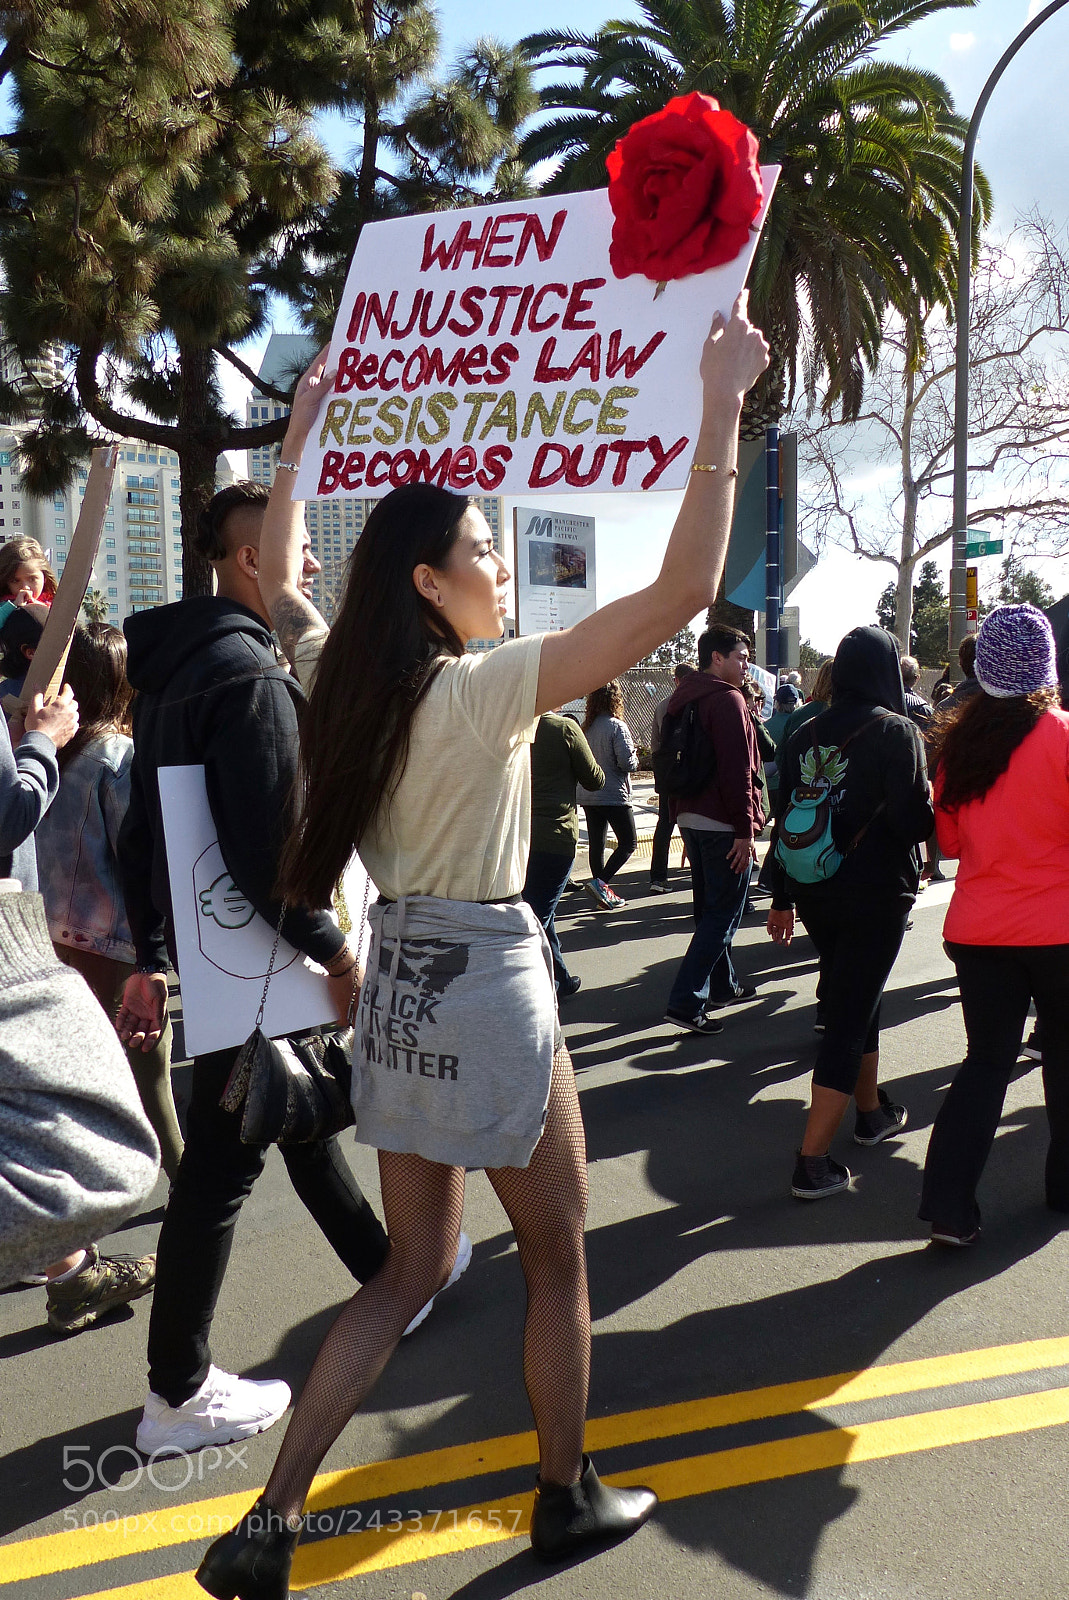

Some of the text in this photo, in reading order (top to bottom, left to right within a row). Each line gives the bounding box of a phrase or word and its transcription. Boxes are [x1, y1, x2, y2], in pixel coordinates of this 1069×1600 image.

[420, 209, 567, 272] WHEN
[346, 277, 607, 344] INJUSTICE
[533, 328, 667, 383] LAW
[319, 385, 639, 447] RESISTANCE
[528, 435, 689, 490] DUTY
[554, 525, 577, 533] PACIFIC
[979, 543, 986, 555] G
